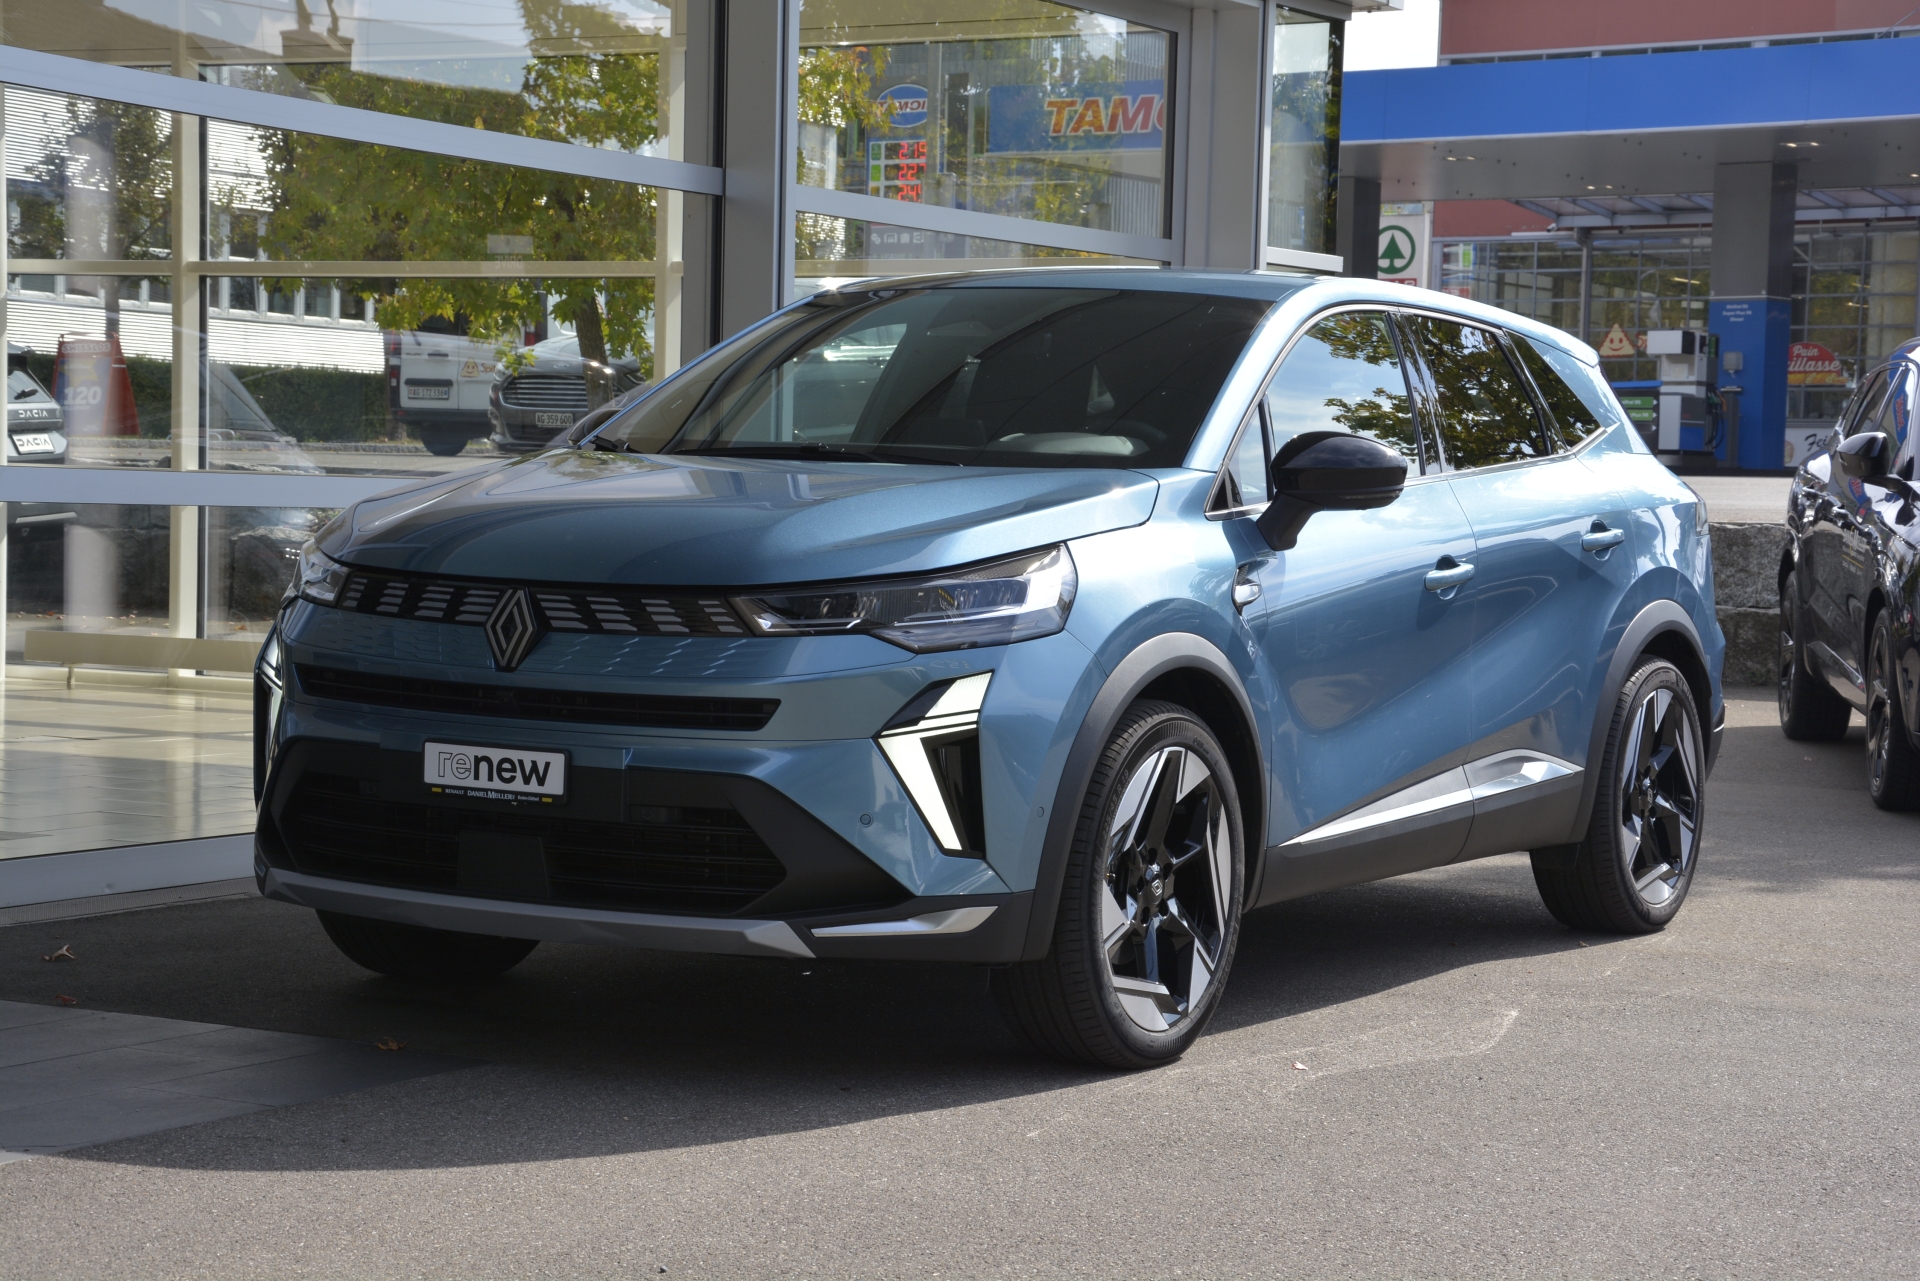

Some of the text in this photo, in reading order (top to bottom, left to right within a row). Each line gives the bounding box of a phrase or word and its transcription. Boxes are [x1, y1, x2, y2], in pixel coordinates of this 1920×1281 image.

[62, 342, 111, 353] SWISSLOS
[1792, 345, 1820, 357] Pain
[1788, 357, 1842, 372] illasse
[64, 385, 102, 405] 120
[18, 409, 49, 418] DACIA
[537, 414, 572, 425] AG 359 600
[16, 437, 51, 447] DACIA
[438, 751, 551, 787] renew
